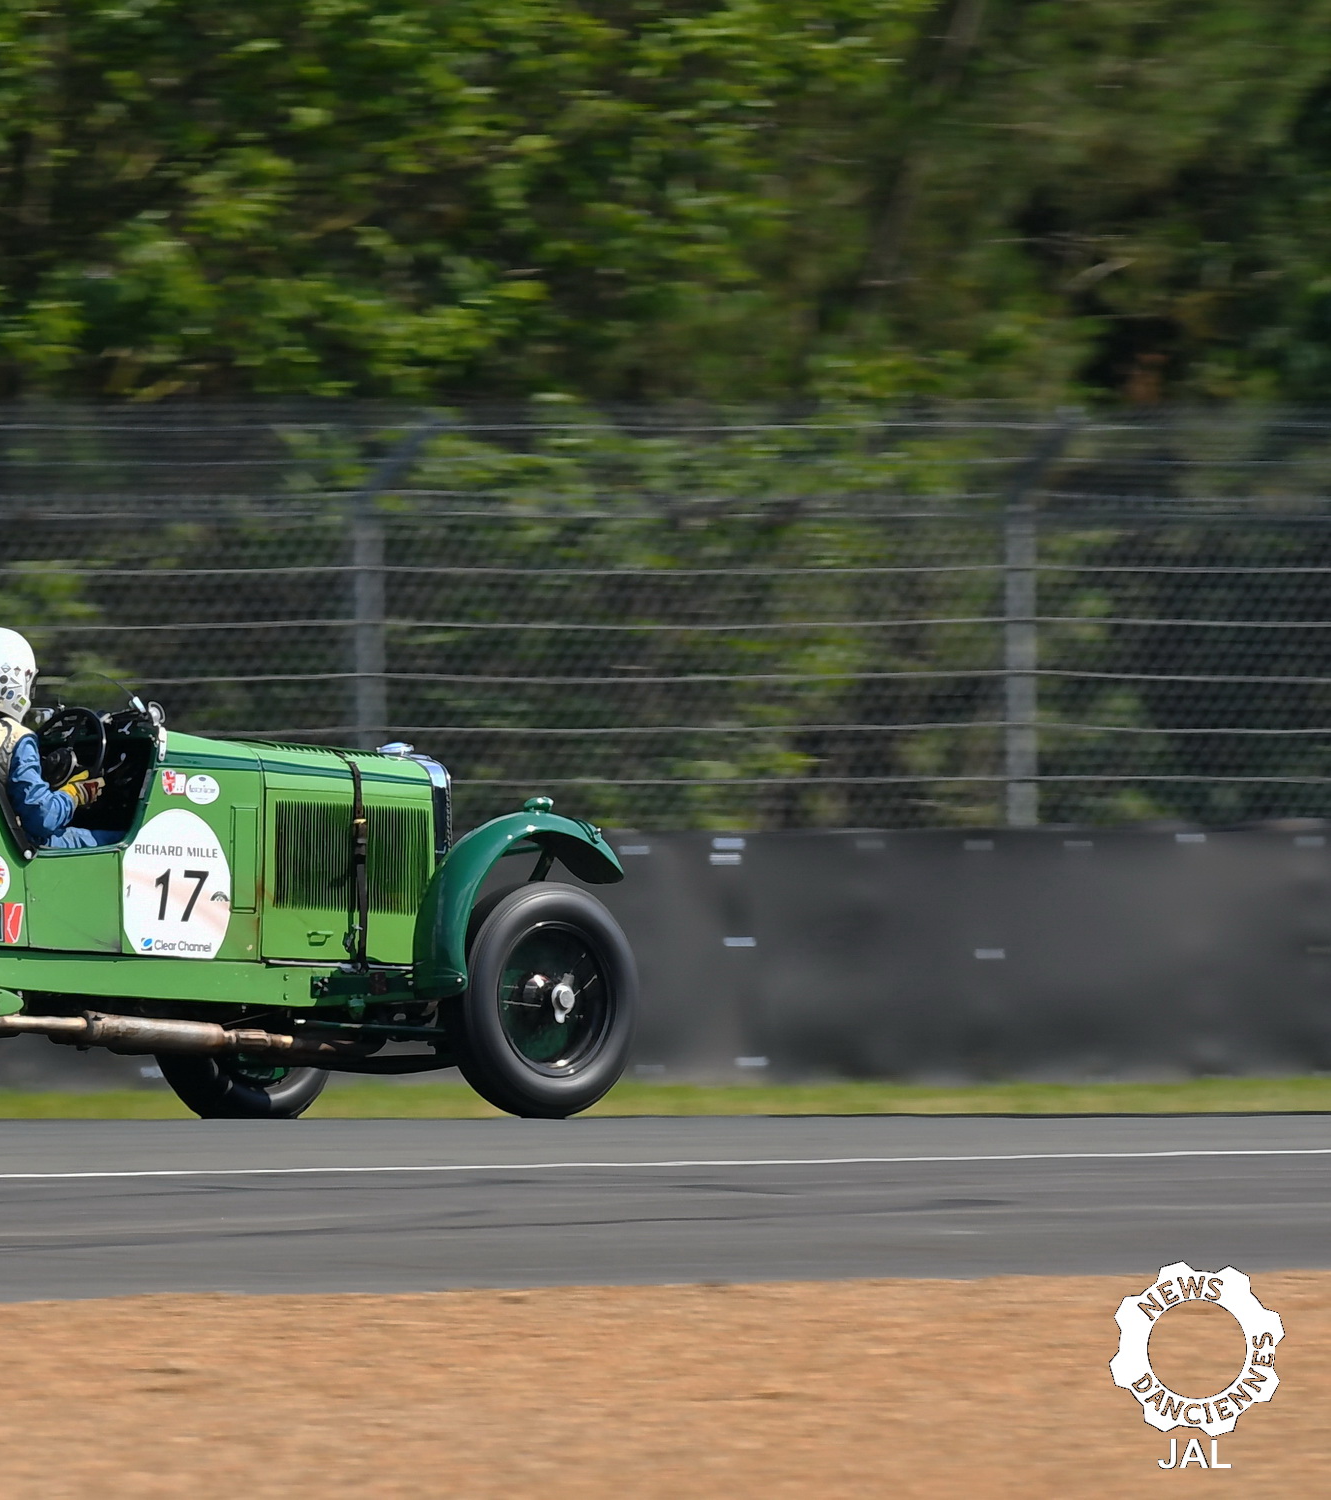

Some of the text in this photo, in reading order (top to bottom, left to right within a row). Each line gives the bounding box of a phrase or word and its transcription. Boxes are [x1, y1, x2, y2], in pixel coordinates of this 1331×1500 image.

[134, 844, 218, 858] RICHARD MILLE
[155, 868, 209, 922] 17
[154, 939, 212, 953] Clear Channel
